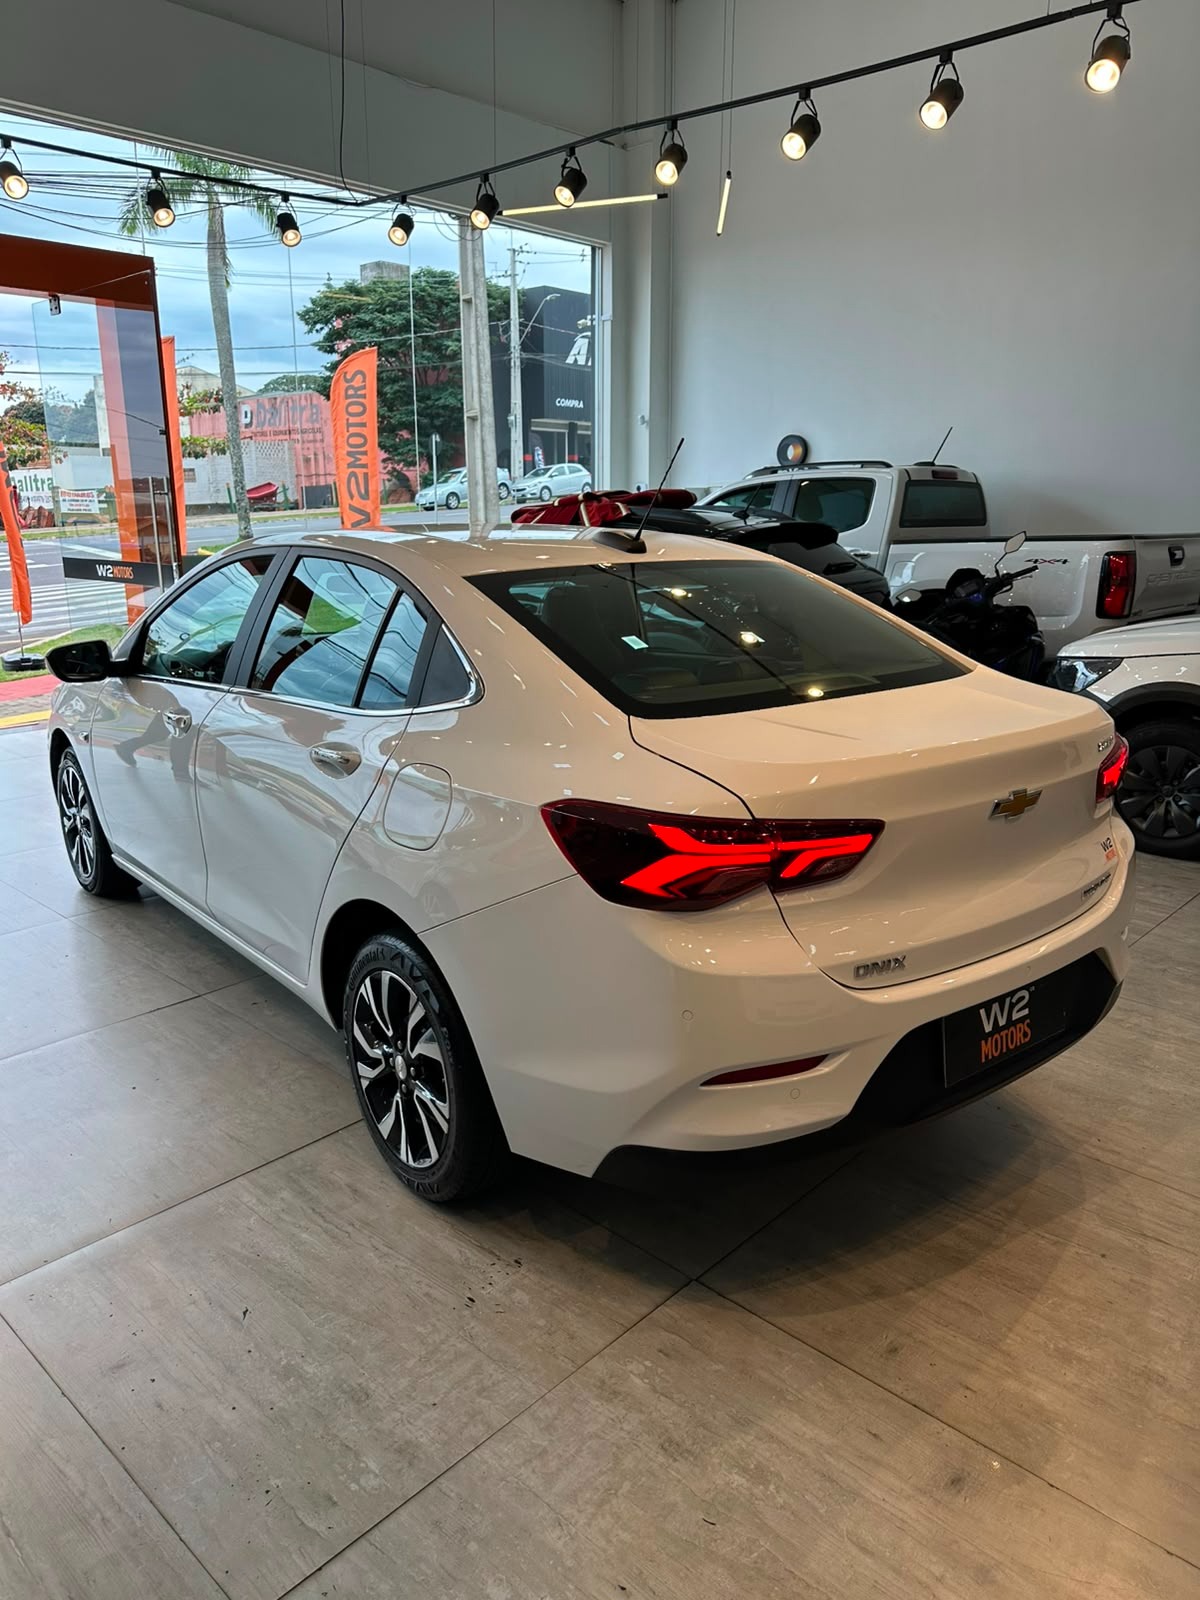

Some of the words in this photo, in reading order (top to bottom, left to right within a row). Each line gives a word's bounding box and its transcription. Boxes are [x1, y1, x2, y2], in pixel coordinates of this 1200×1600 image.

[555, 398, 584, 408] COMPRA
[1100, 837, 1113, 852] W2
[854, 955, 906, 977] ONIX
[979, 989, 1030, 1033] W2
[981, 1019, 1032, 1063] MOTORS
